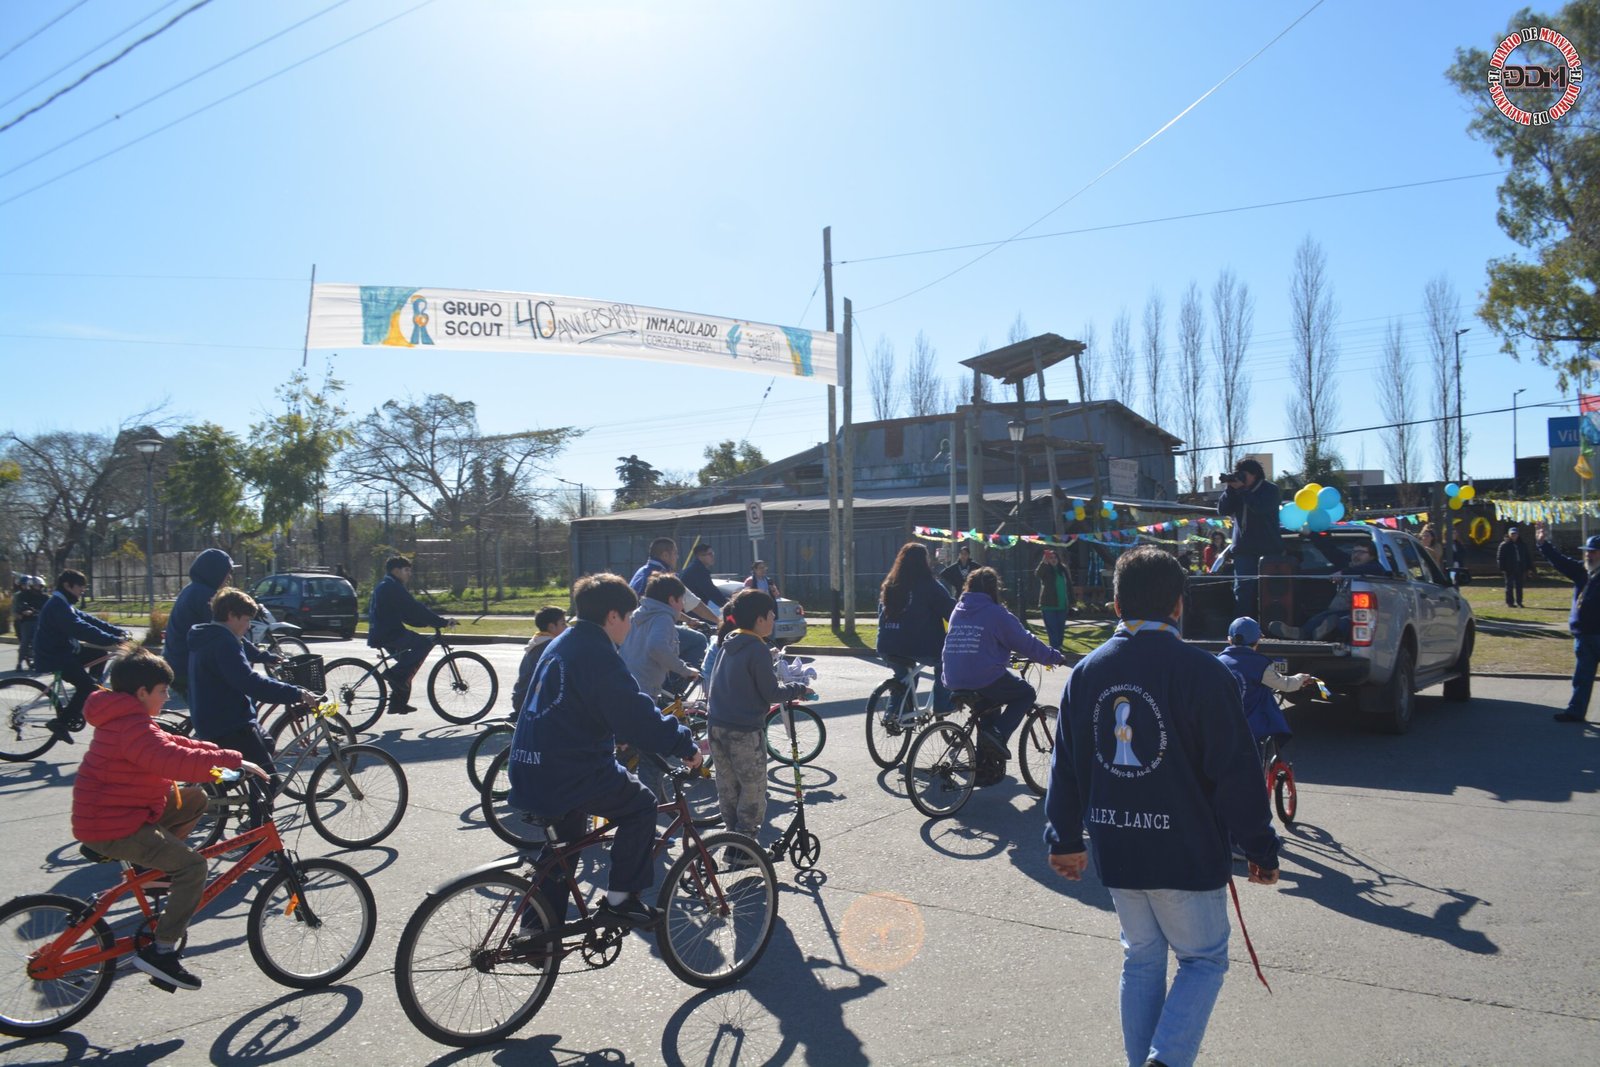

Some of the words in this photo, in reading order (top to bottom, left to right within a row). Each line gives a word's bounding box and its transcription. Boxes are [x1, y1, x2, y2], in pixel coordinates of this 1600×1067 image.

[443, 301, 501, 317] GRUPO
[445, 321, 503, 337] SCOUT
[646, 316, 717, 338] INMACULADO
[1159, 731, 1168, 750] MARIA
[1090, 807, 1170, 830] ALEX_LANCE
